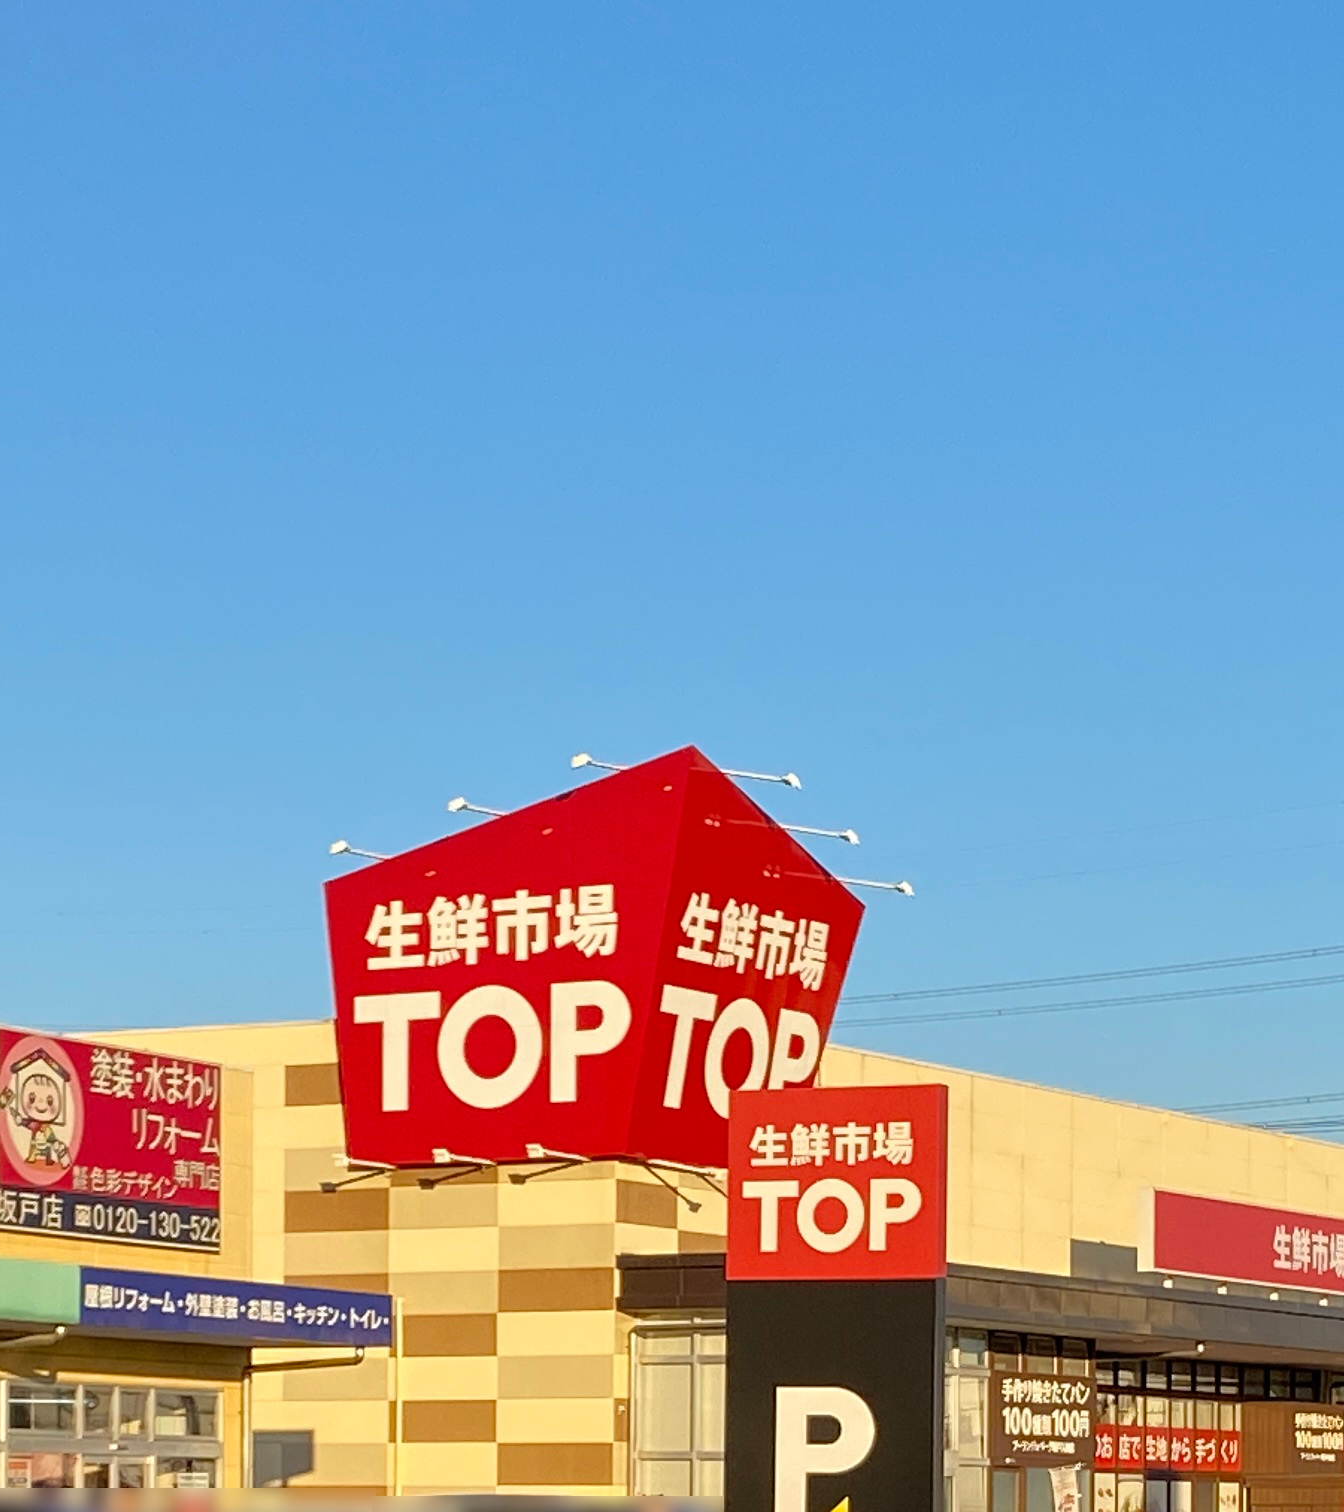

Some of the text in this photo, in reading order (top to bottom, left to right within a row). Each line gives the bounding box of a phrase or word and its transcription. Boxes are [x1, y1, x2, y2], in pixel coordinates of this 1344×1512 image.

[365, 885, 618, 970] 生鮮市場
[676, 892, 829, 992] 生鮮市場
[89, 1048, 219, 1111] 塗装・水まわり
[353, 980, 632, 1112] TOP
[660, 985, 820, 1120] TOP
[131, 1107, 220, 1157] リフォーム
[749, 1121, 914, 1167] 生鮮市場
[173, 1159, 220, 1192] 専門店
[93, 1204, 220, 1243] 0120-130-522
[742, 1178, 922, 1253] TOP
